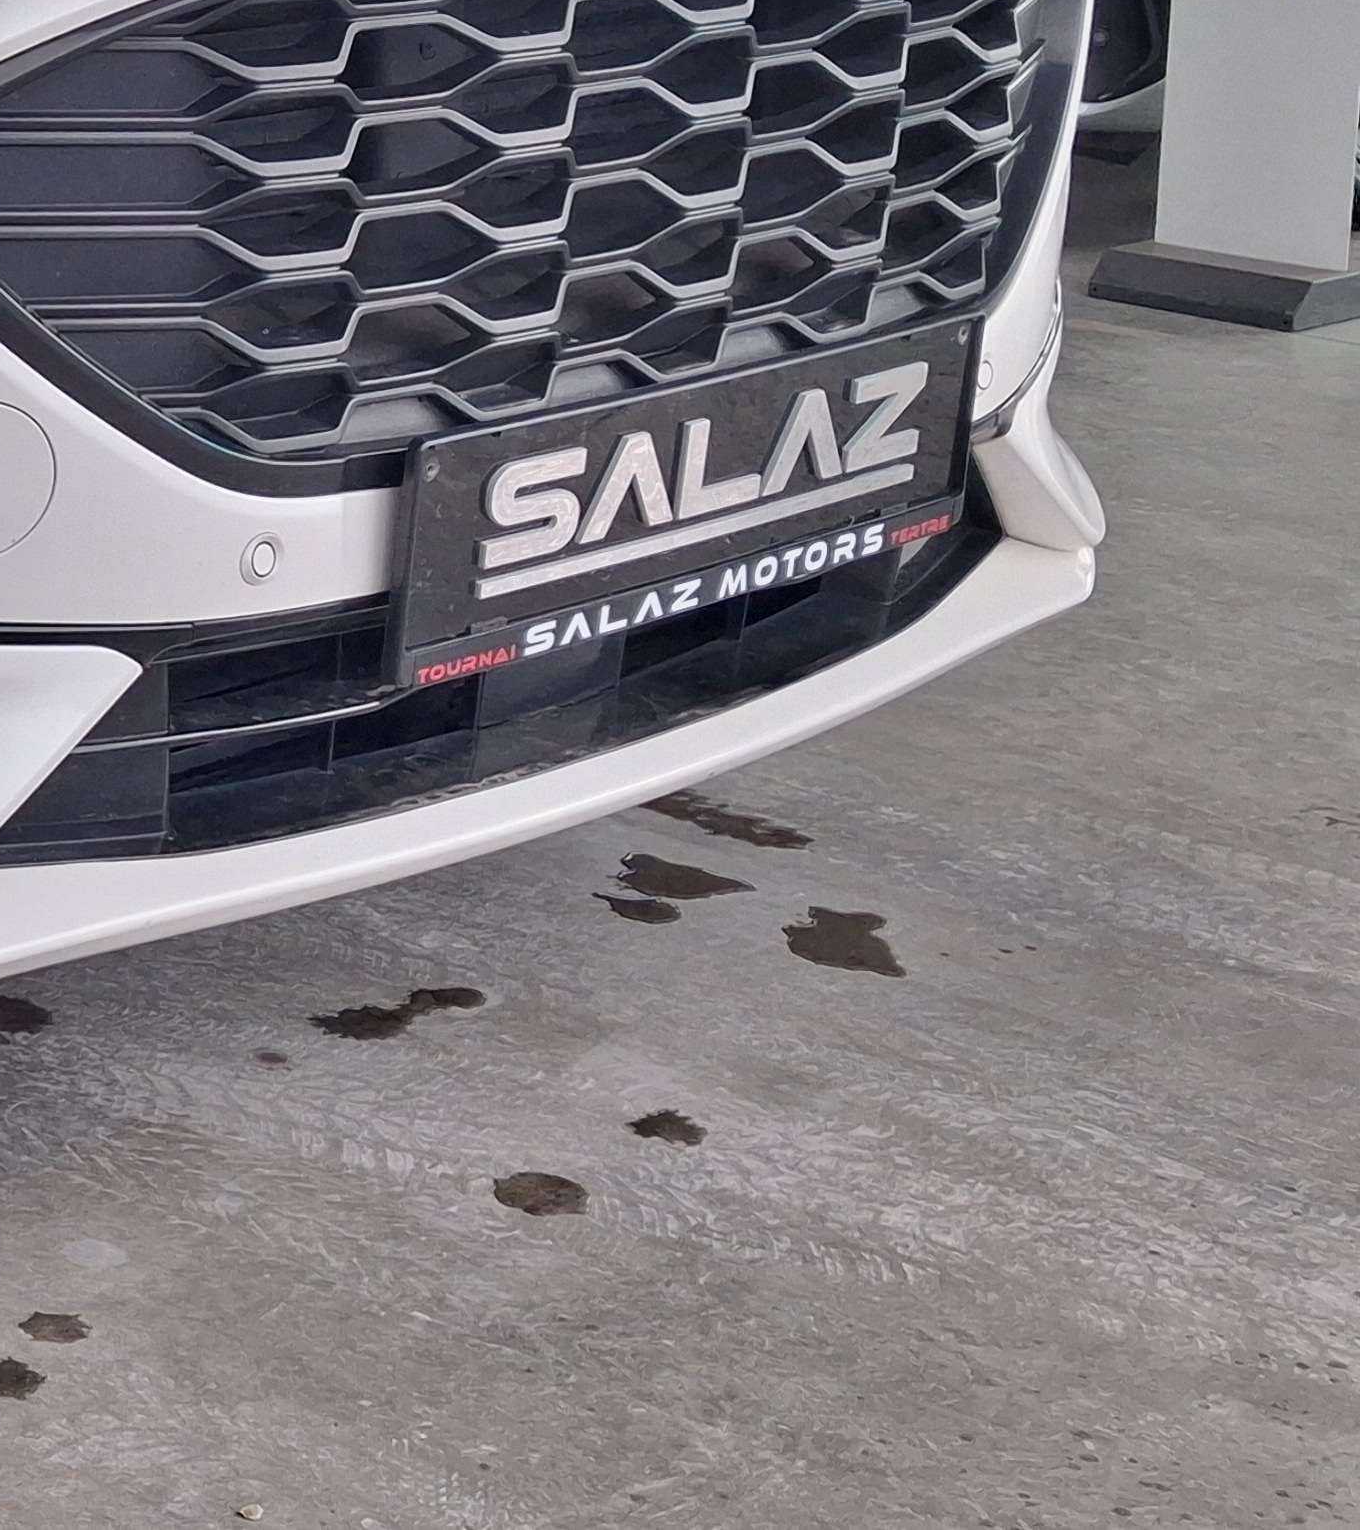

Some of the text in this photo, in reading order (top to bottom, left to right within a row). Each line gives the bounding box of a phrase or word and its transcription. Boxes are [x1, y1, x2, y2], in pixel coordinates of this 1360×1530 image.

[479, 361, 929, 571] SALAZ
[417, 644, 517, 684] TOURNAI
[523, 578, 702, 657] SALAZ
[718, 523, 885, 599] MOTORS
